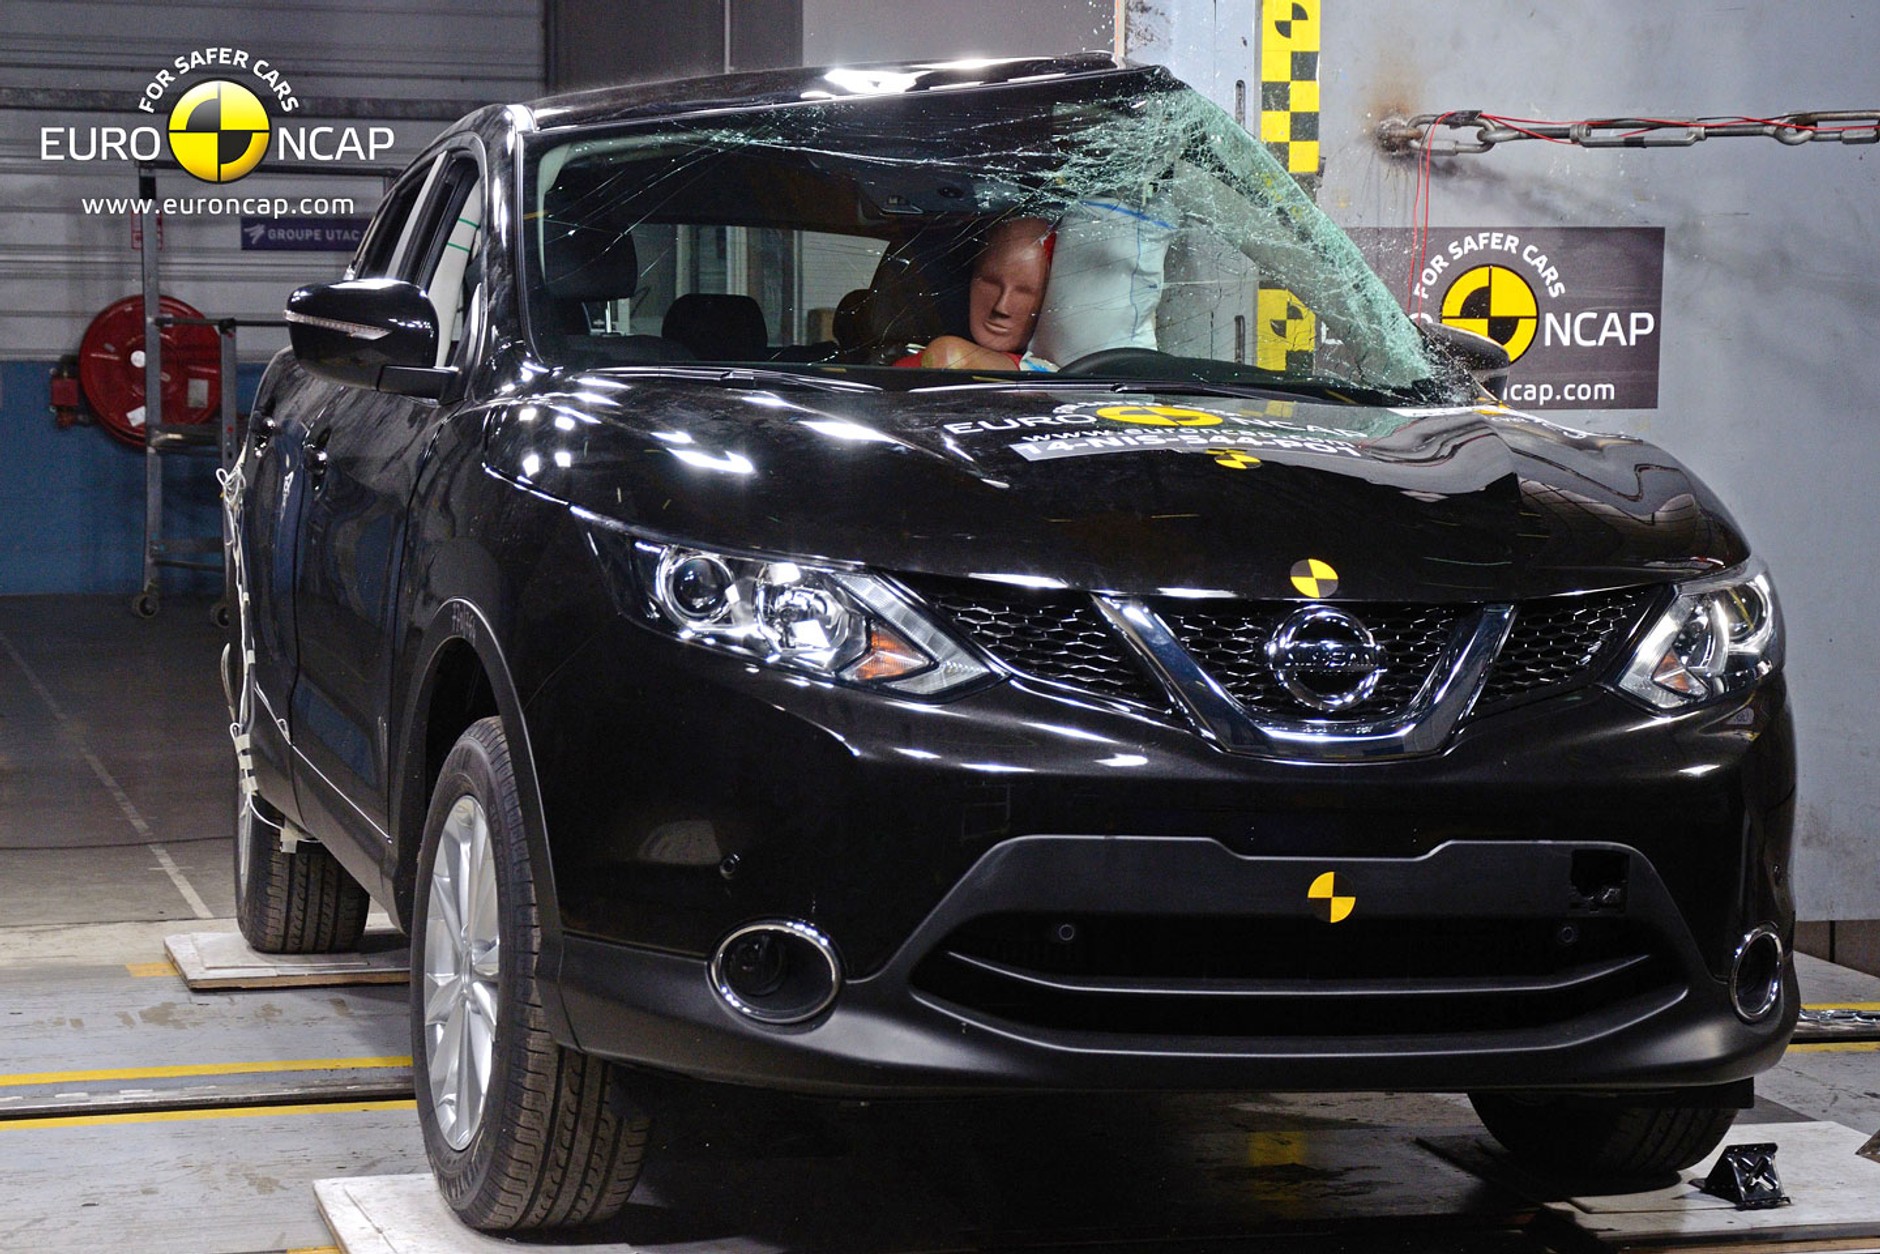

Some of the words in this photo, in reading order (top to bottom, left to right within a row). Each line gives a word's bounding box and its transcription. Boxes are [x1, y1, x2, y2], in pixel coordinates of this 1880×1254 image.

[267, 228, 323, 241] GROUPE
[325, 229, 360, 241] UTAC
[1413, 253, 1450, 300] FOR
[1447, 231, 1521, 261] SAFER
[1521, 244, 1566, 299] CARS
[1543, 311, 1656, 348] NCAP
[942, 413, 1098, 436] EURO
